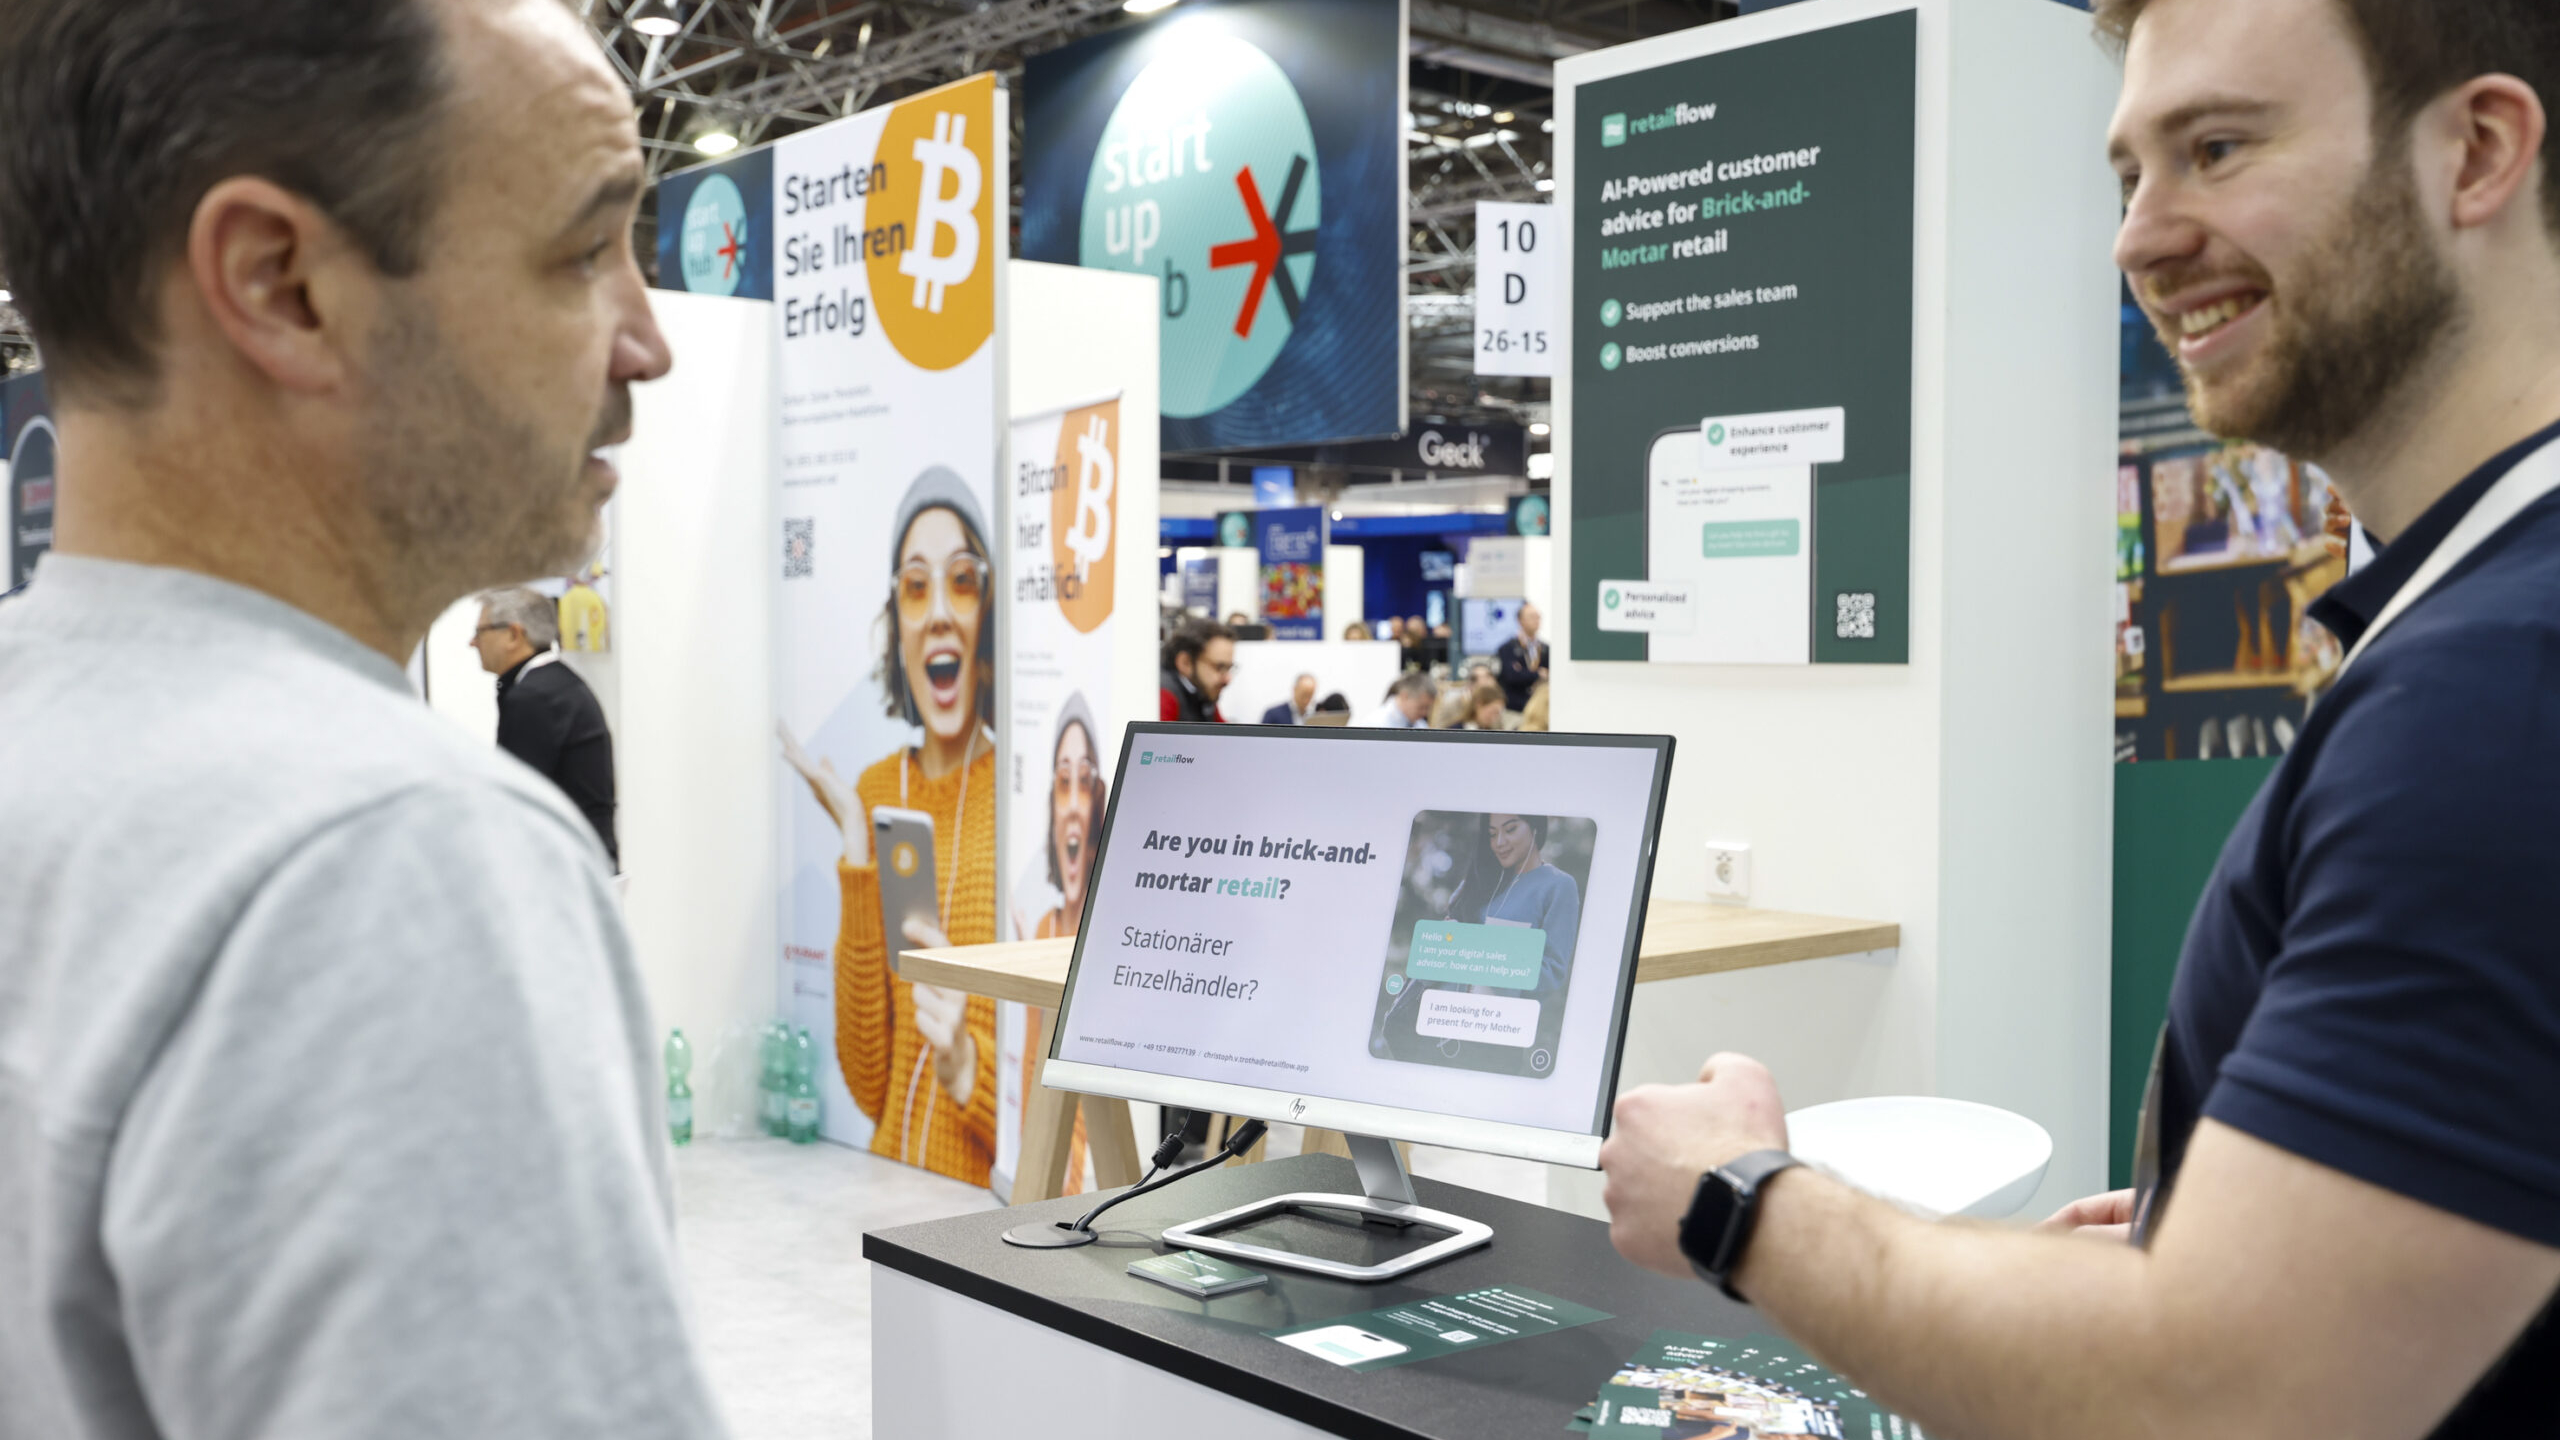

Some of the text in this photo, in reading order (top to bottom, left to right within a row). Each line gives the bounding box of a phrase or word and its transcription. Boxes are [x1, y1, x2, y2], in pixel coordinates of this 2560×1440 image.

[1630, 102, 1717, 134] retailflow
[1103, 109, 1214, 193] start
[784, 161, 887, 215] Starten
[1601, 146, 1821, 203] AI-Powered customer
[1601, 180, 1811, 236] advice for Brick-and-
[785, 221, 906, 277] Sie Ihren
[1105, 200, 1161, 266] up
[1498, 220, 1536, 252] 10
[1602, 228, 1728, 270] Mortar retail
[1504, 273, 1526, 304] D
[1626, 284, 1798, 322] Support the sales team
[785, 288, 865, 338] Erfolg
[1482, 329, 1547, 353] 26-15
[1626, 333, 1759, 363] Boost conversions
[1730, 425, 1774, 439] Enhance
[1418, 430, 1484, 468] Geck
[1018, 456, 1069, 497] Bitcoin
[1016, 514, 1044, 549] hier
[1154, 754, 1195, 765] retailflow
[1143, 830, 1377, 865] Are you in brick-and-
[1135, 871, 1291, 900] mortar retail?
[1121, 925, 1233, 957] Stationärer
[1421, 932, 1443, 942] Hello
[1438, 948, 1458, 958] your
[1459, 948, 1485, 960] digital
[1486, 951, 1508, 961] sales
[1450, 961, 1469, 970] how
[1469, 964, 1483, 972] can
[1490, 965, 1510, 976] help
[1510, 968, 1531, 977] you?
[1113, 965, 1259, 1001] Einzelhändler?
[1427, 1017, 1521, 1034] present for my Mother
[1450, 1004, 1480, 1017] looking
[1482, 1008, 1495, 1017] for
[1079, 1035, 1135, 1049] www.retailflow.app
[1156, 1044, 1167, 1052] 157
[1292, 1098, 1306, 1120] hp
